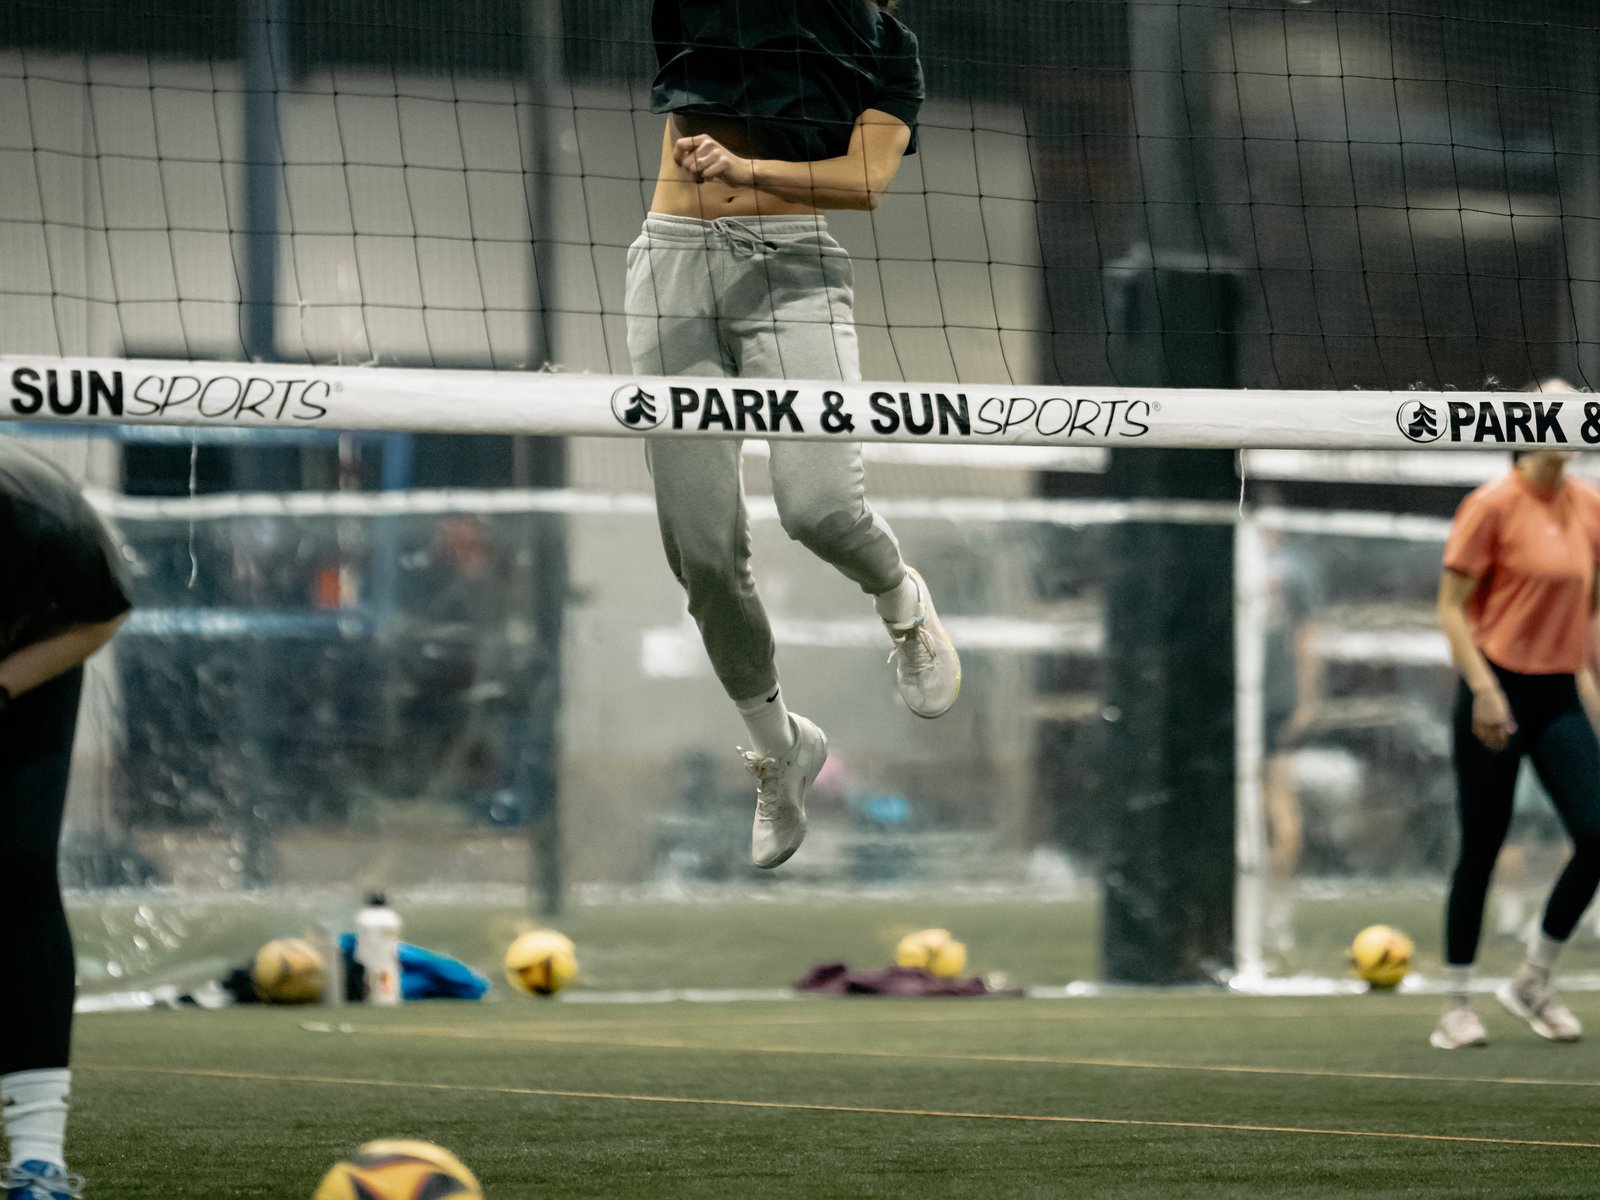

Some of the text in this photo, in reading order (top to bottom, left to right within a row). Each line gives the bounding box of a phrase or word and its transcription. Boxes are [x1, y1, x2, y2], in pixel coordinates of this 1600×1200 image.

[669, 386, 804, 433] PARK
[820, 390, 855, 435] &
[1447, 401, 1568, 443] PARK
